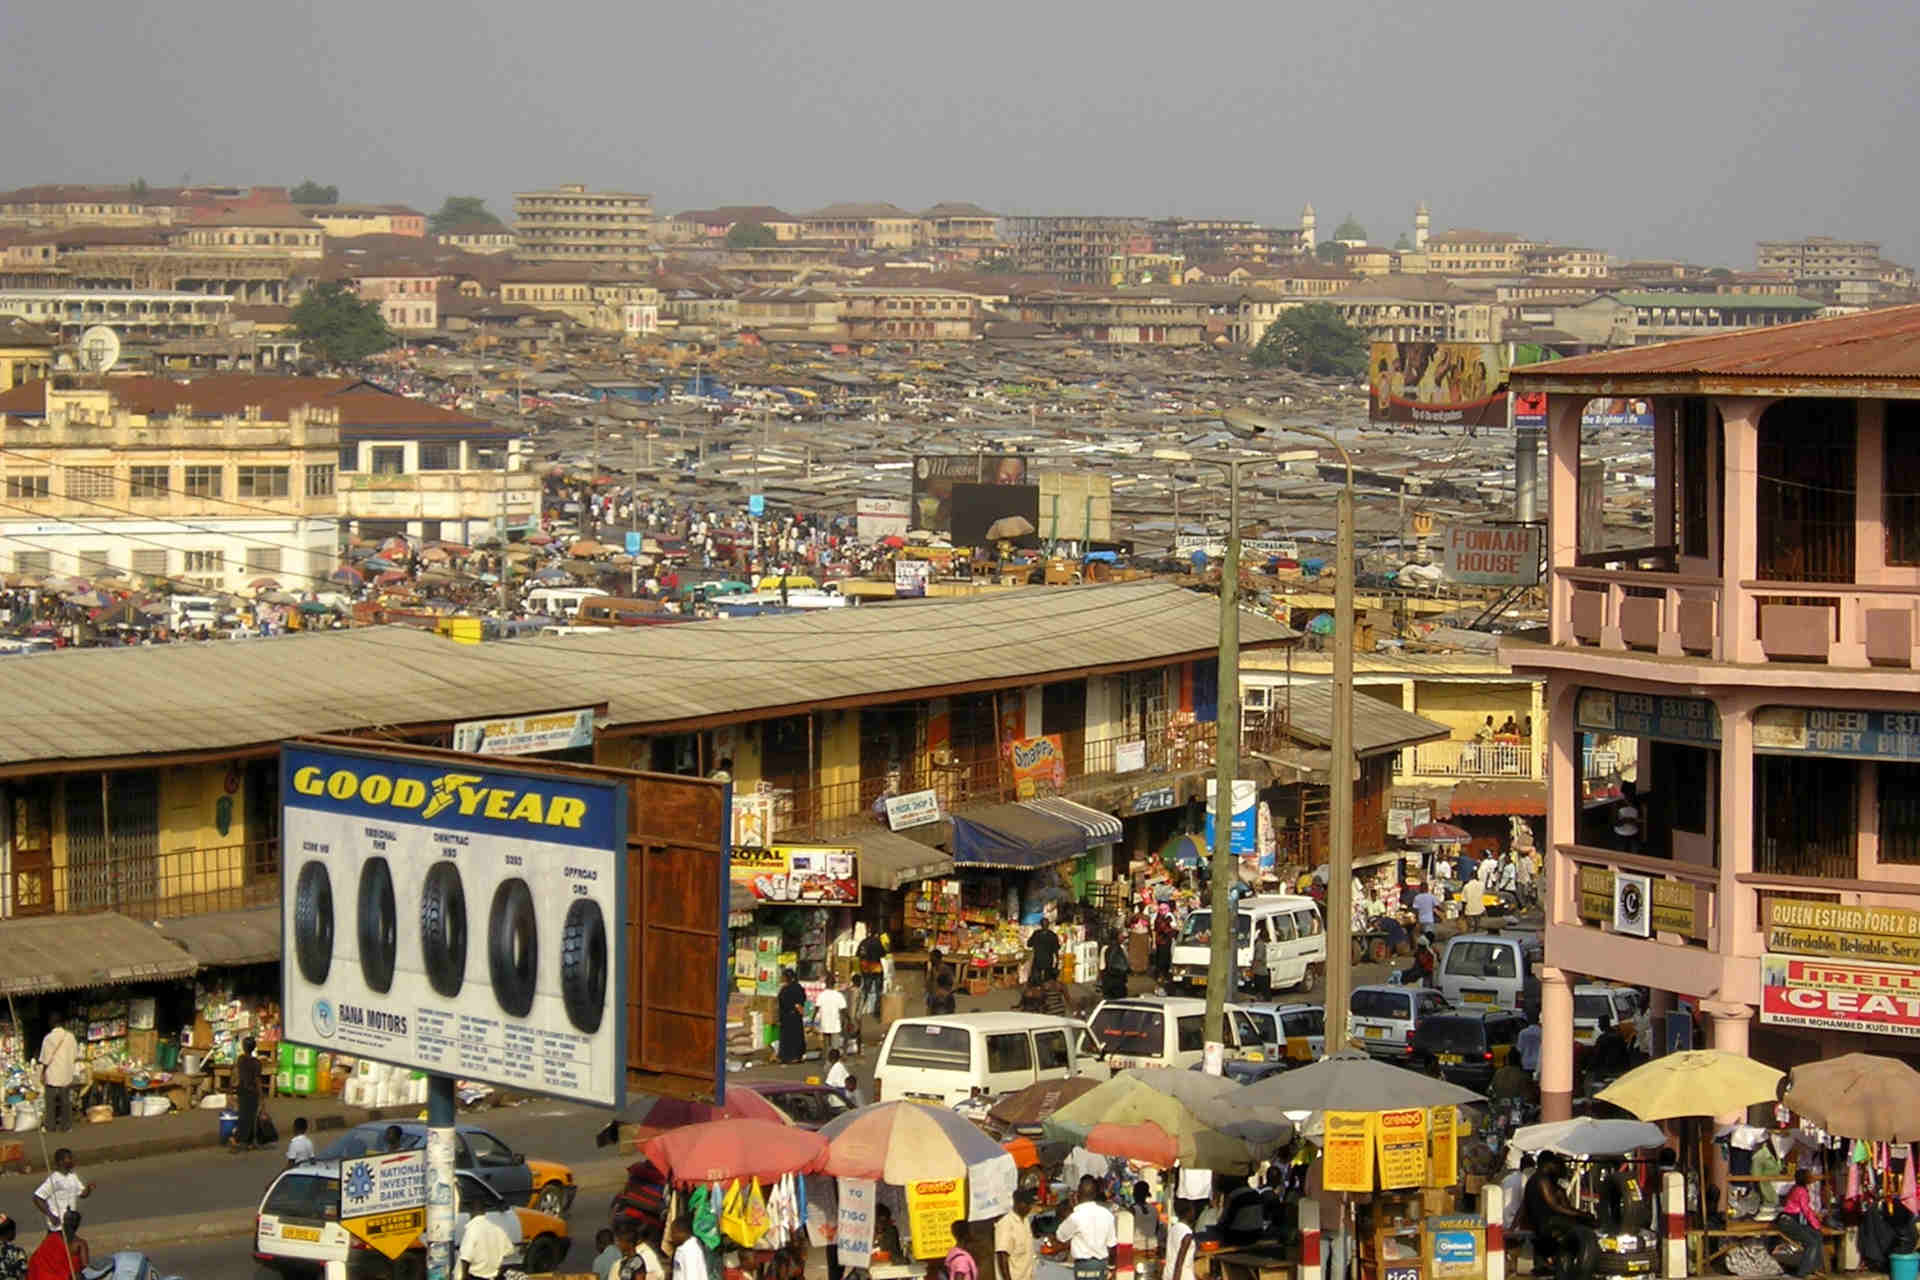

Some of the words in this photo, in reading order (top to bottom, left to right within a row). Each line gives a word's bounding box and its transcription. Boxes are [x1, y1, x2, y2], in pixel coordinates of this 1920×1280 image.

[1452, 528, 1529, 552] FOWAAH
[1456, 552, 1521, 576] HOUSE
[1810, 711, 1869, 733] QUEEN
[1807, 730, 1862, 751] FOREX
[1773, 904, 1812, 926] QUEEN
[1815, 909, 1862, 931] ESTHER
[1864, 912, 1905, 933] FOREX
[1839, 936, 1888, 953] Reliable
[1787, 989, 1920, 1018] CEAT
[339, 1003, 364, 1025] RANA
[366, 1008, 408, 1035] MOTORS
[1772, 1015, 1807, 1026] BASHIR
[1809, 1018, 1864, 1031] MOHAMMED
[1865, 1024, 1889, 1033] KUDI
[380, 1188, 405, 1201] BANK
